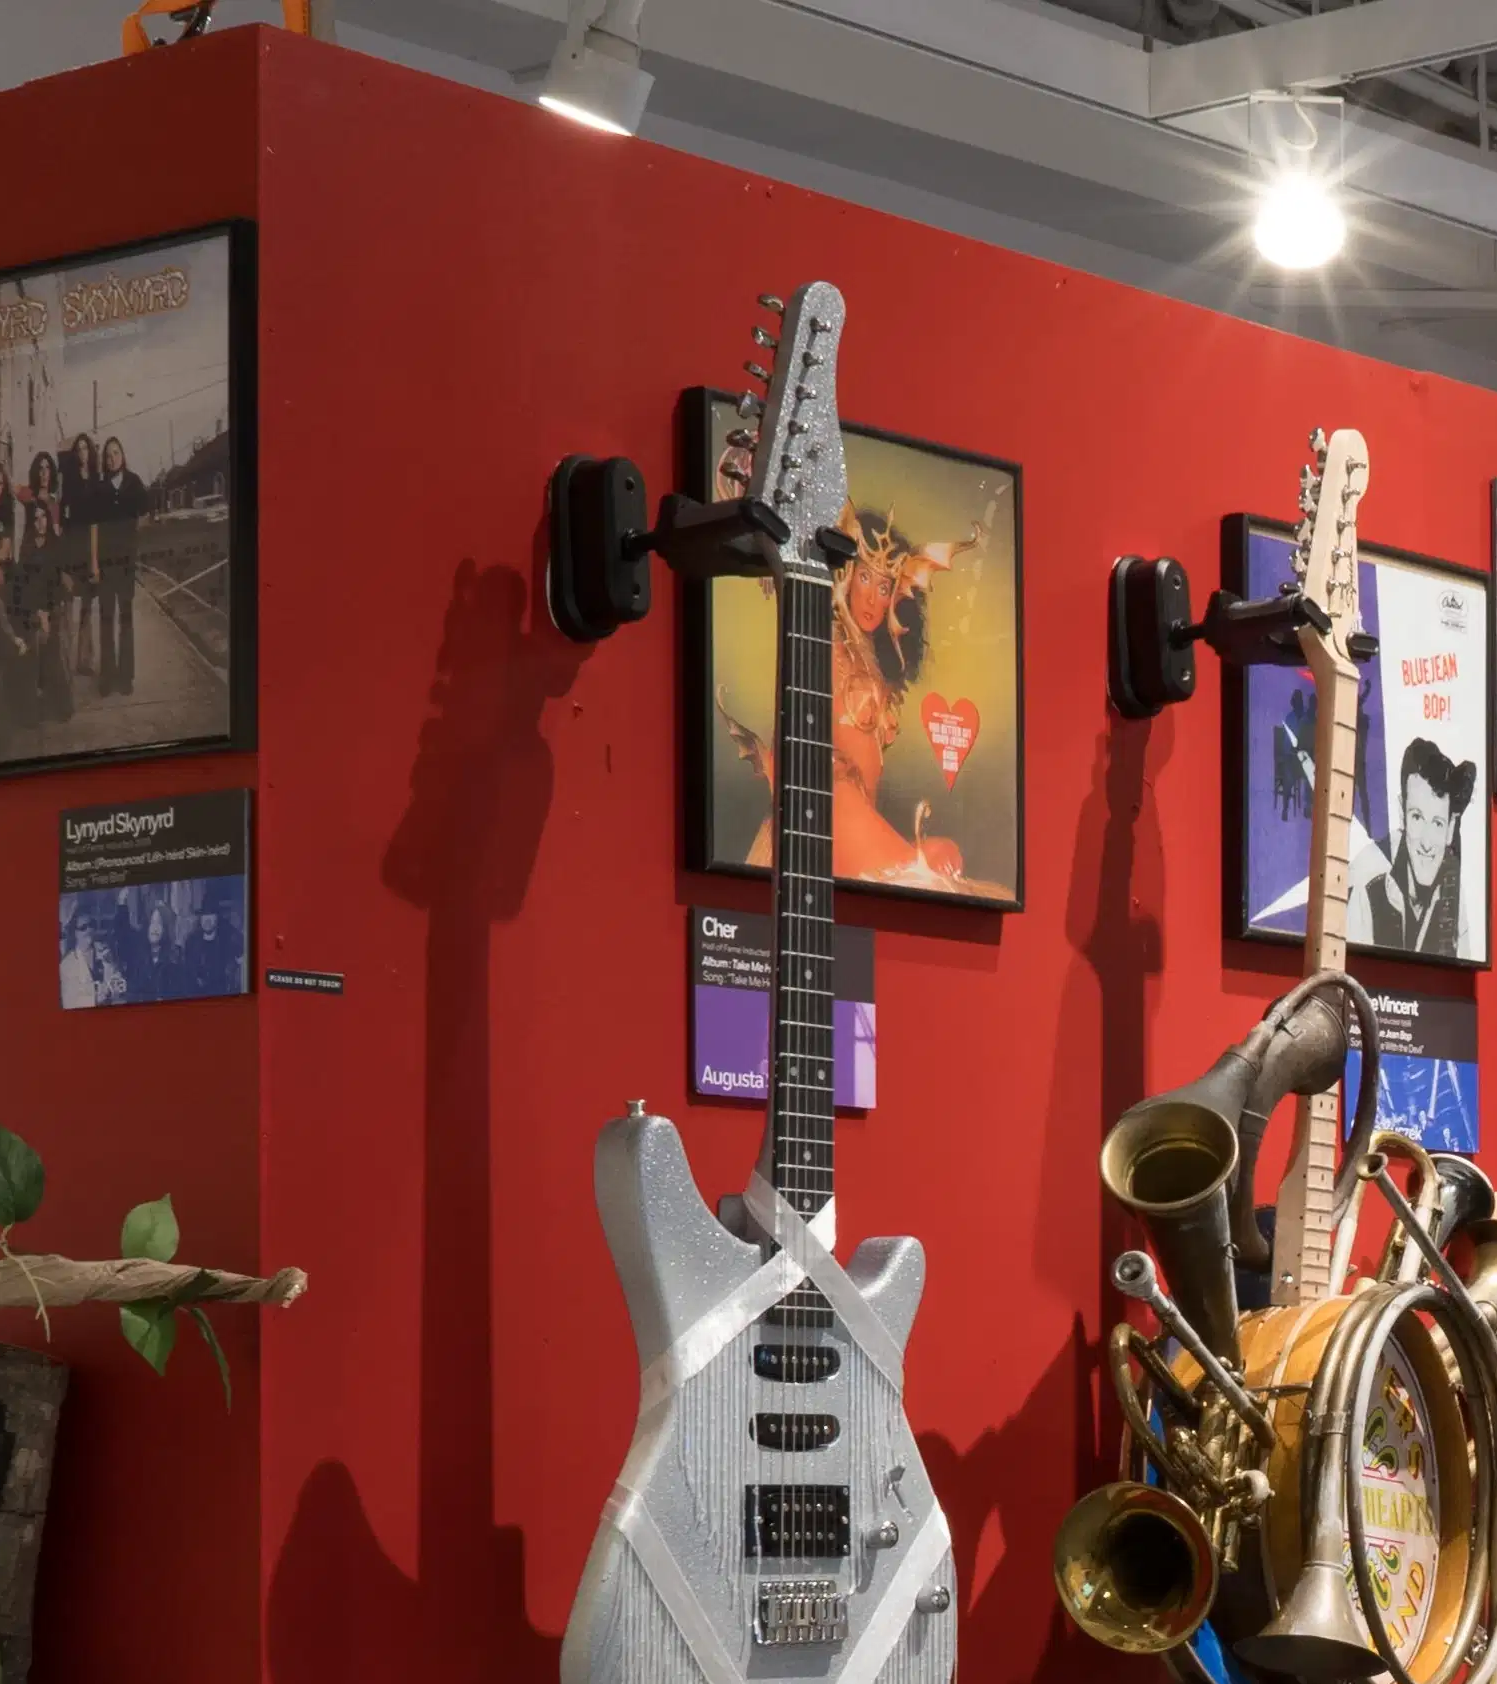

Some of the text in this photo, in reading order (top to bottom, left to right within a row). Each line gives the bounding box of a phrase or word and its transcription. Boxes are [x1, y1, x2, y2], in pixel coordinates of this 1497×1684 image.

[62, 267, 190, 329] SKYNYRD
[1423, 693, 1451, 721] BOP!
[66, 807, 174, 844] Lynyrd Skynyrd
[702, 916, 738, 939] Cher
[1378, 994, 1419, 1017] Vincent
[702, 1064, 765, 1091] Augusta
